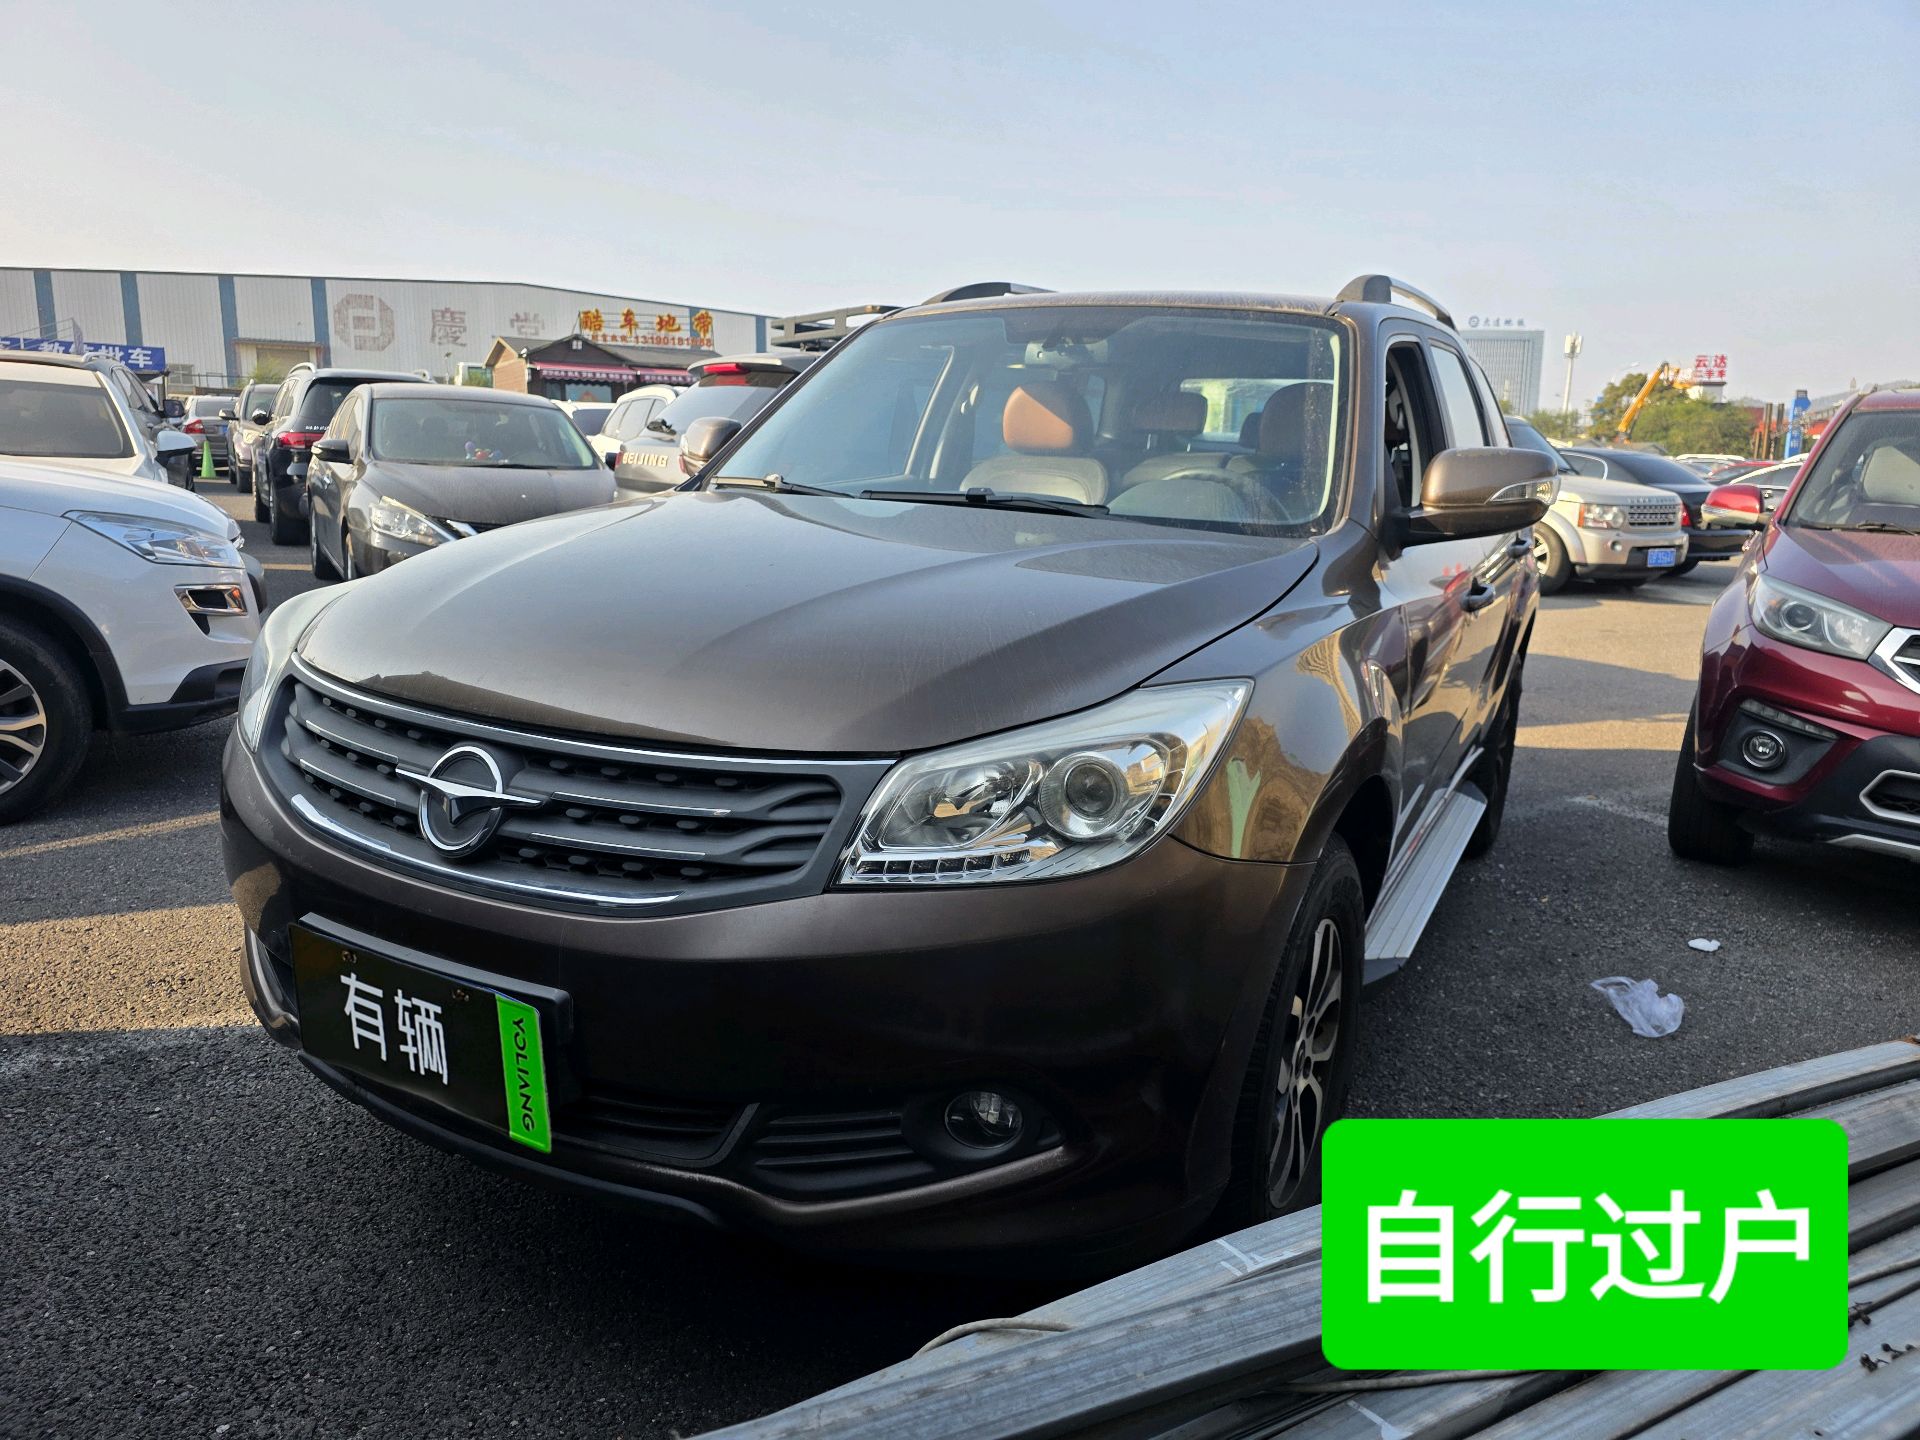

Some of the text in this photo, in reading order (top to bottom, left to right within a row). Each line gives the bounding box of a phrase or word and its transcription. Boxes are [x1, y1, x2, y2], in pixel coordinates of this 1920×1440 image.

[581, 308, 713, 338] 酷车地带
[1696, 354, 1727, 368] 云达
[622, 451, 668, 468] BEIJING
[340, 972, 448, 1086] 有辆
[511, 1017, 536, 1133] YOLIANG
